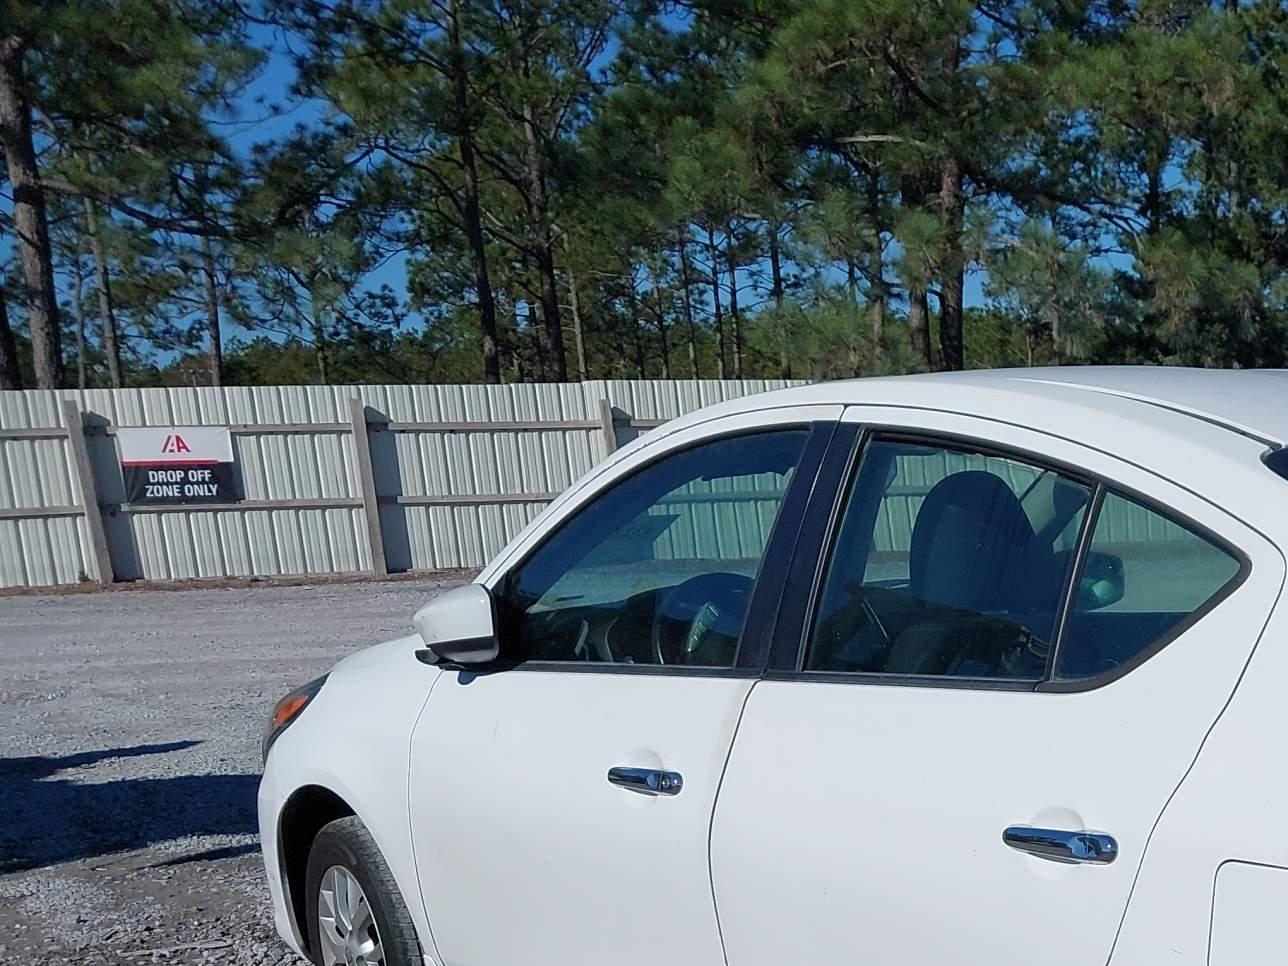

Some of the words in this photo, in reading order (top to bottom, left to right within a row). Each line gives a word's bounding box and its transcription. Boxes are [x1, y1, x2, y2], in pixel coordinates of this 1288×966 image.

[148, 470, 185, 483] DROP
[188, 469, 212, 482] OFF
[144, 484, 182, 497] ZONE
[184, 483, 219, 496] ONLY
